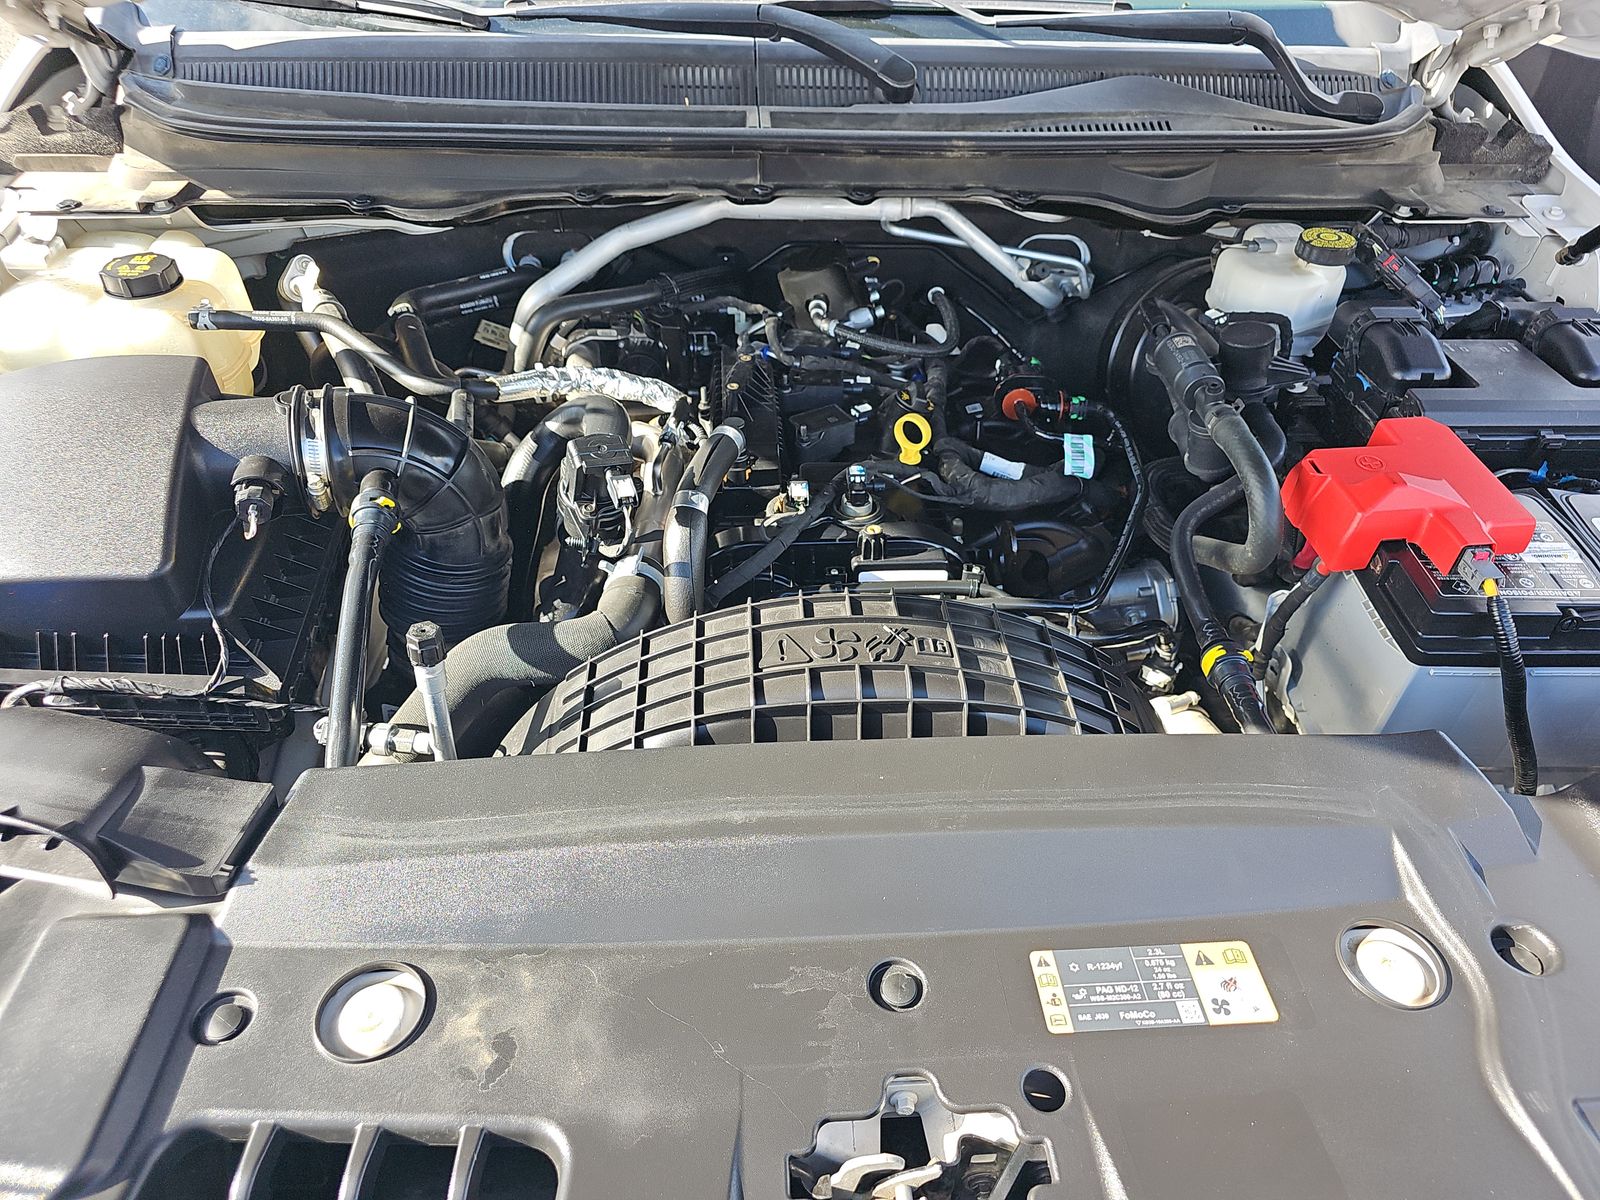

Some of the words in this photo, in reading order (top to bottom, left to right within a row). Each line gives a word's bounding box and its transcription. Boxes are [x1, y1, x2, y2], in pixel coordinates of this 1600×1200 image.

[1147, 948, 1165, 956] 2.3L
[1087, 961, 1123, 971] R-1234yf
[1095, 986, 1114, 994] PAG
[1115, 984, 1139, 994] ND-12
[1152, 982, 1164, 990] 2.7
[1174, 982, 1185, 990] oz
[1119, 1010, 1156, 1020] FoMoCo
